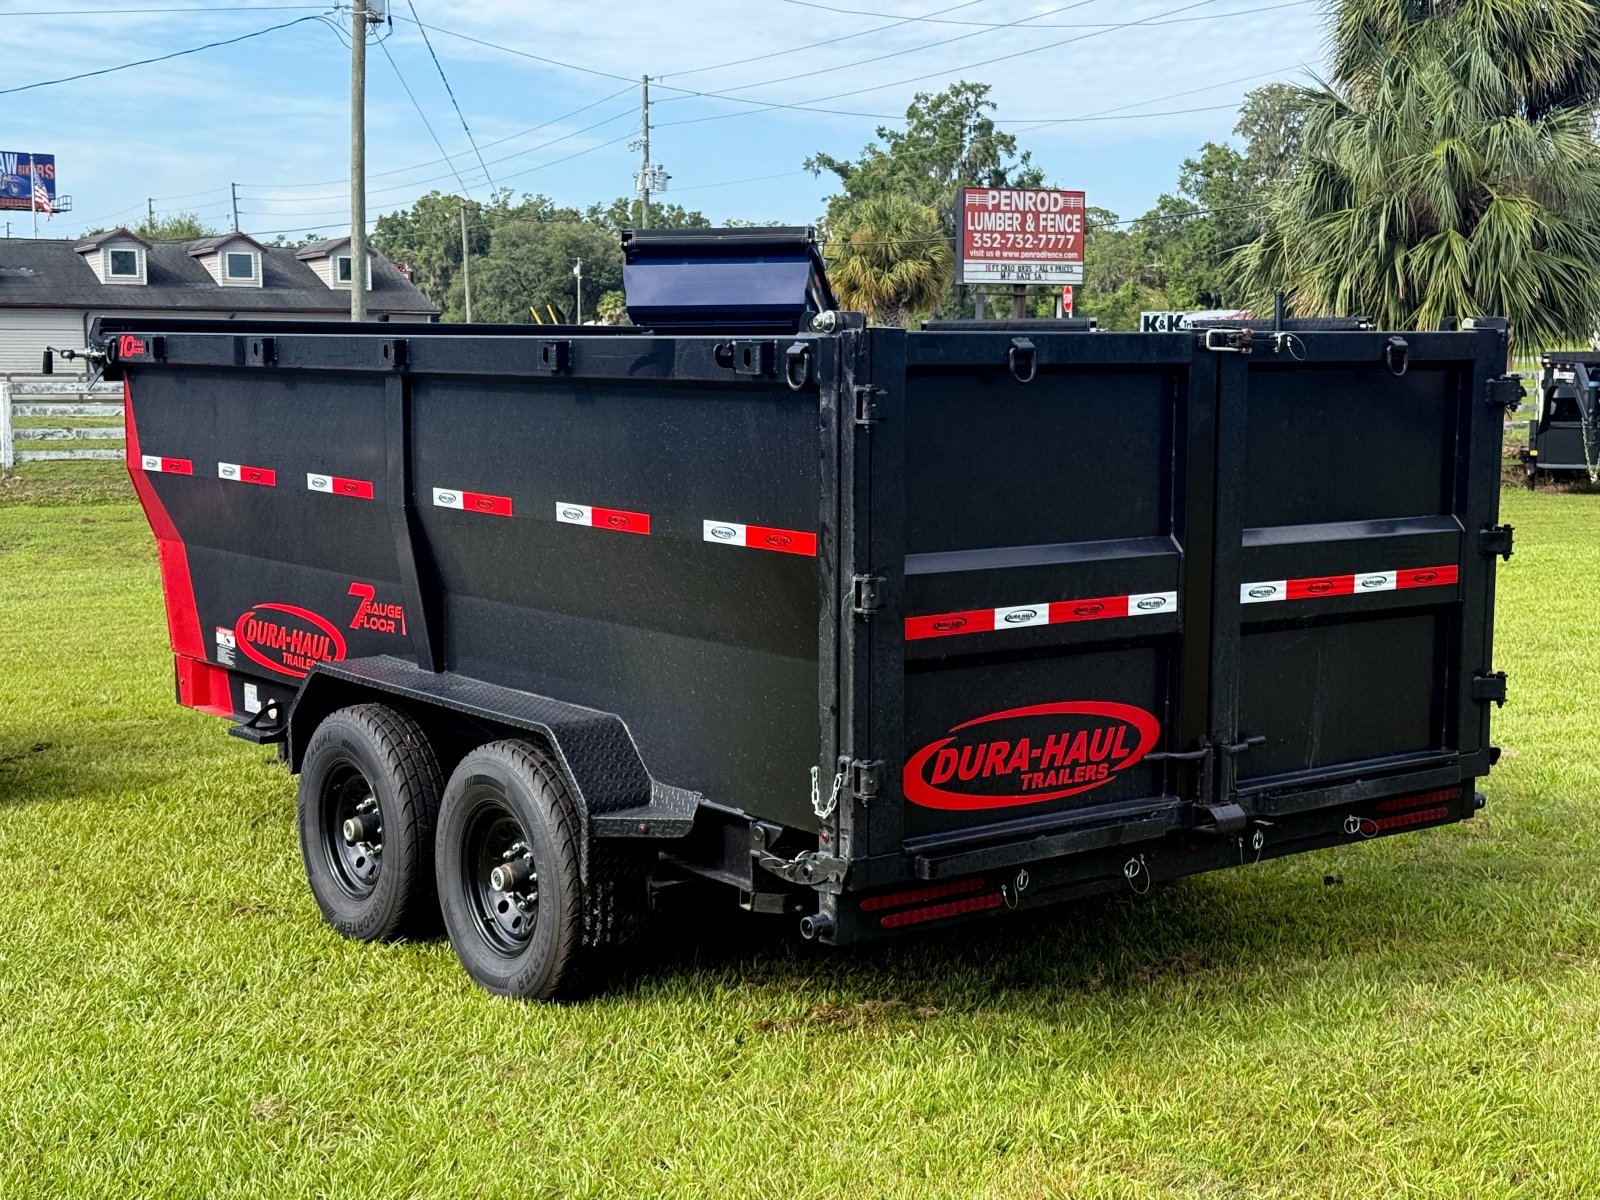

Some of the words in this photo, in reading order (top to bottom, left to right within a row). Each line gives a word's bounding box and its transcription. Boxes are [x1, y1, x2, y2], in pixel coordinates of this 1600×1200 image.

[18, 163, 54, 179] BIKRS
[987, 190, 1062, 212] PENROD
[967, 212, 1021, 232] LUMBER
[1025, 213, 1035, 232] &
[1039, 213, 1081, 233] FENCE
[972, 233, 1075, 249] 352-732-7777
[1002, 251, 1078, 259] www.penrodfence.com
[1055, 265, 1074, 273] PRICES
[1143, 314, 1183, 332] K&K
[119, 335, 135, 357] 10
[347, 582, 375, 630] 7
[363, 600, 402, 619] GAUGE
[358, 614, 395, 634] FLOOR
[246, 618, 332, 663] DURA-HAUL
[930, 725, 1130, 785] DURA-HAUL
[1020, 763, 1109, 790] TRAILERS
